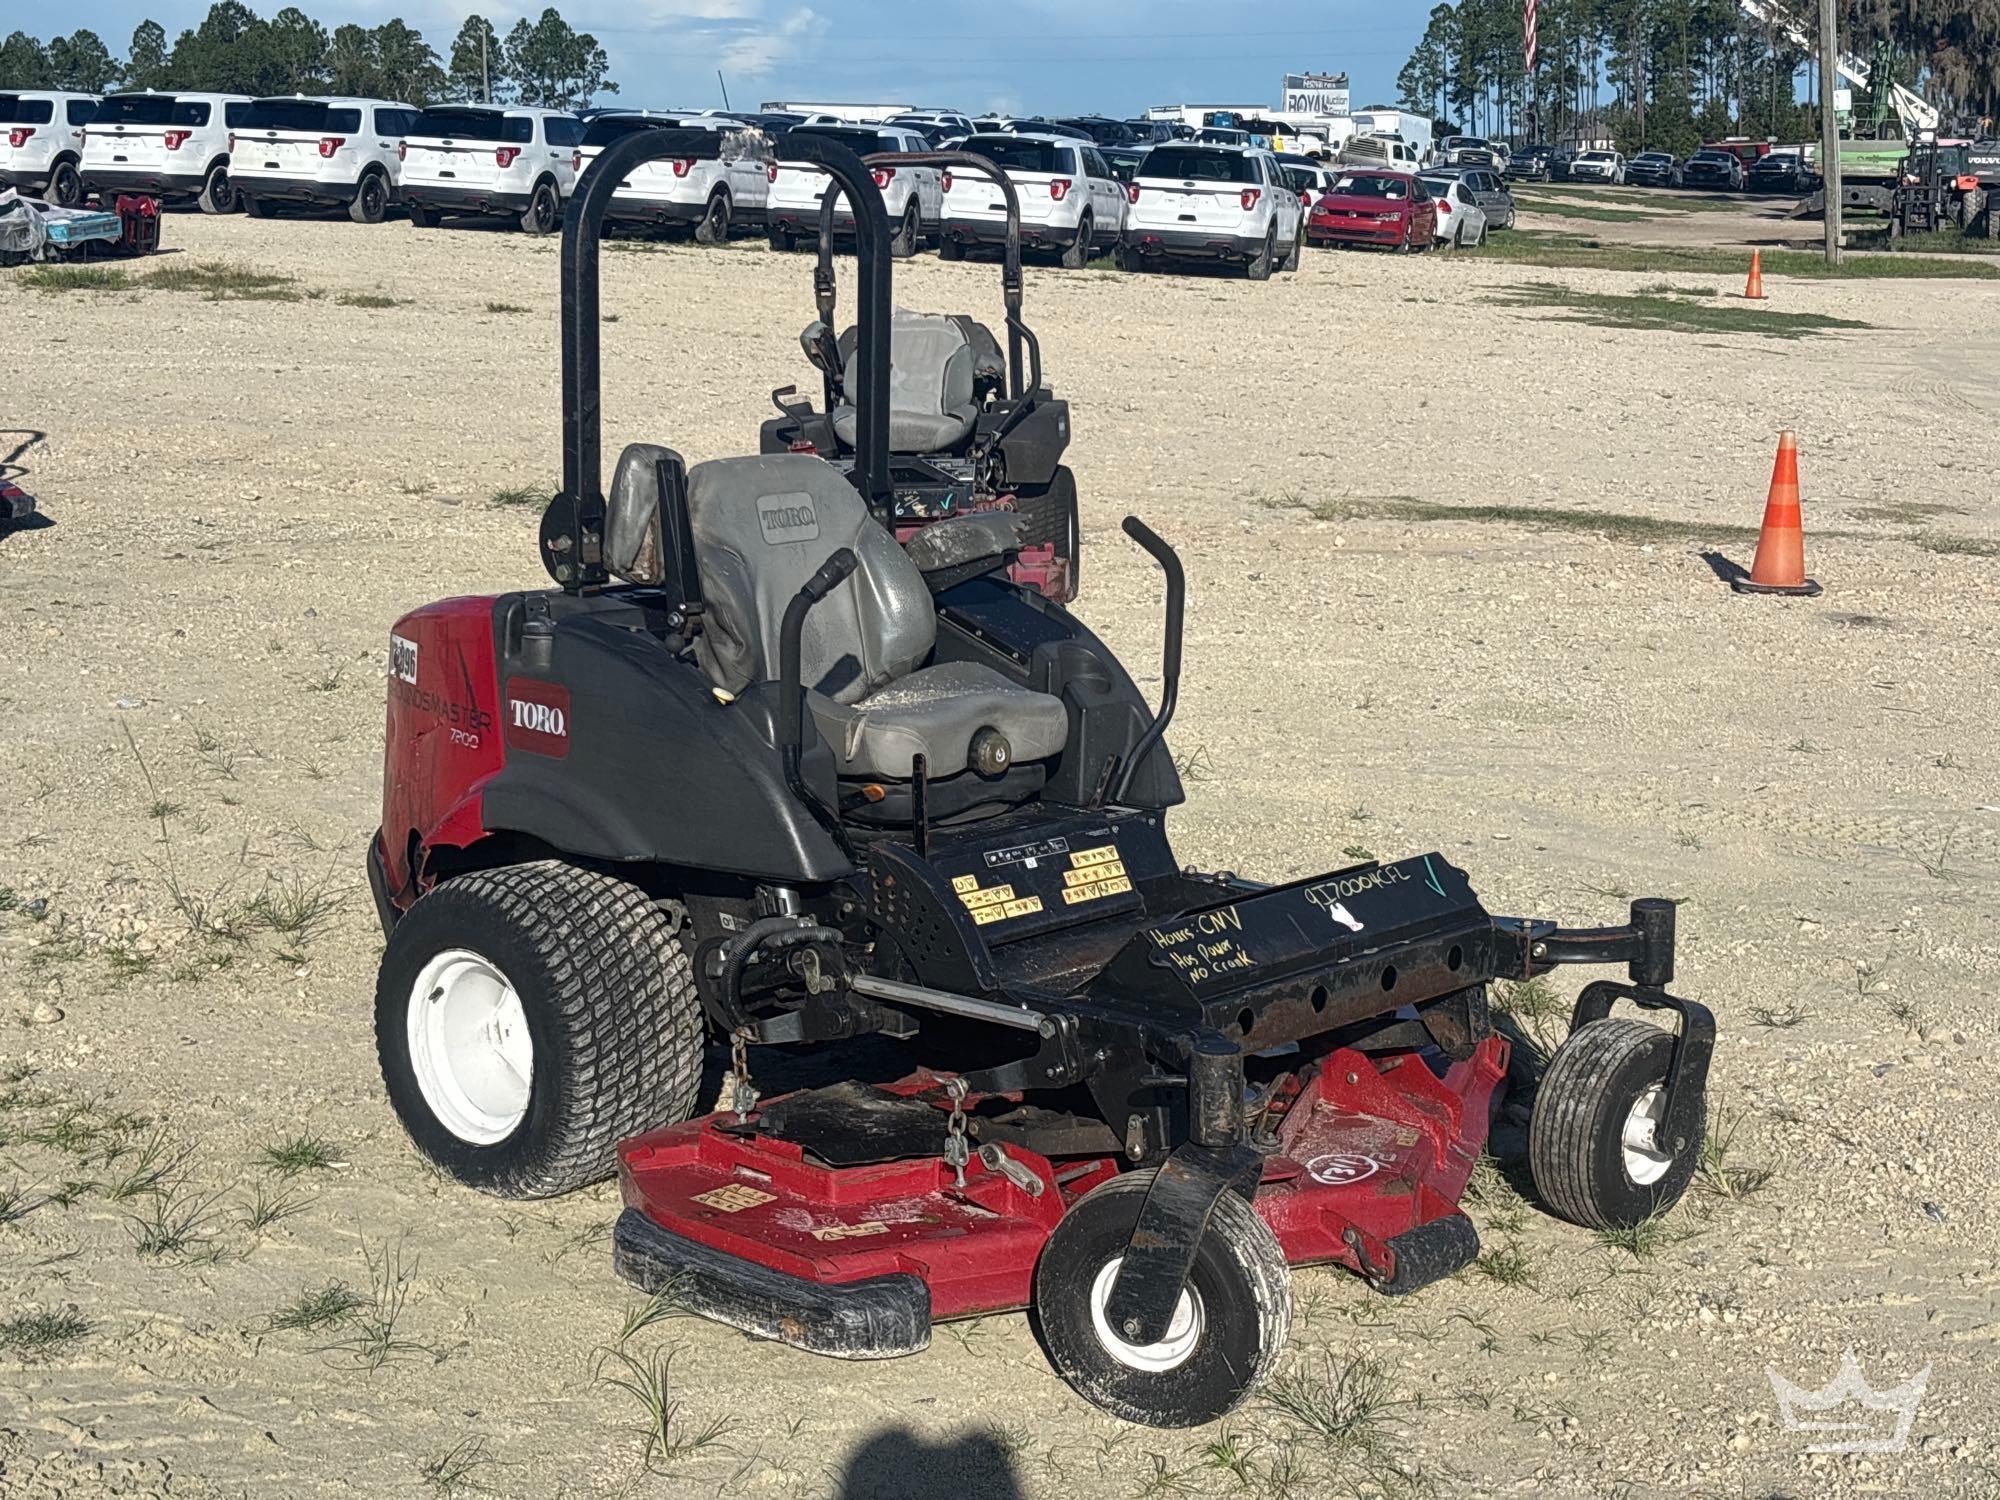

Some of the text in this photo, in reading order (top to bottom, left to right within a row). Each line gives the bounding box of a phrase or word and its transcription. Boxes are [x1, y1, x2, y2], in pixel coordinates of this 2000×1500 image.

[1289, 94, 1327, 113] ROYAL
[762, 506, 814, 530] TORO
[511, 699, 566, 737] TORO
[1198, 905, 1242, 934] CNV
[1169, 952, 1199, 969] Has
